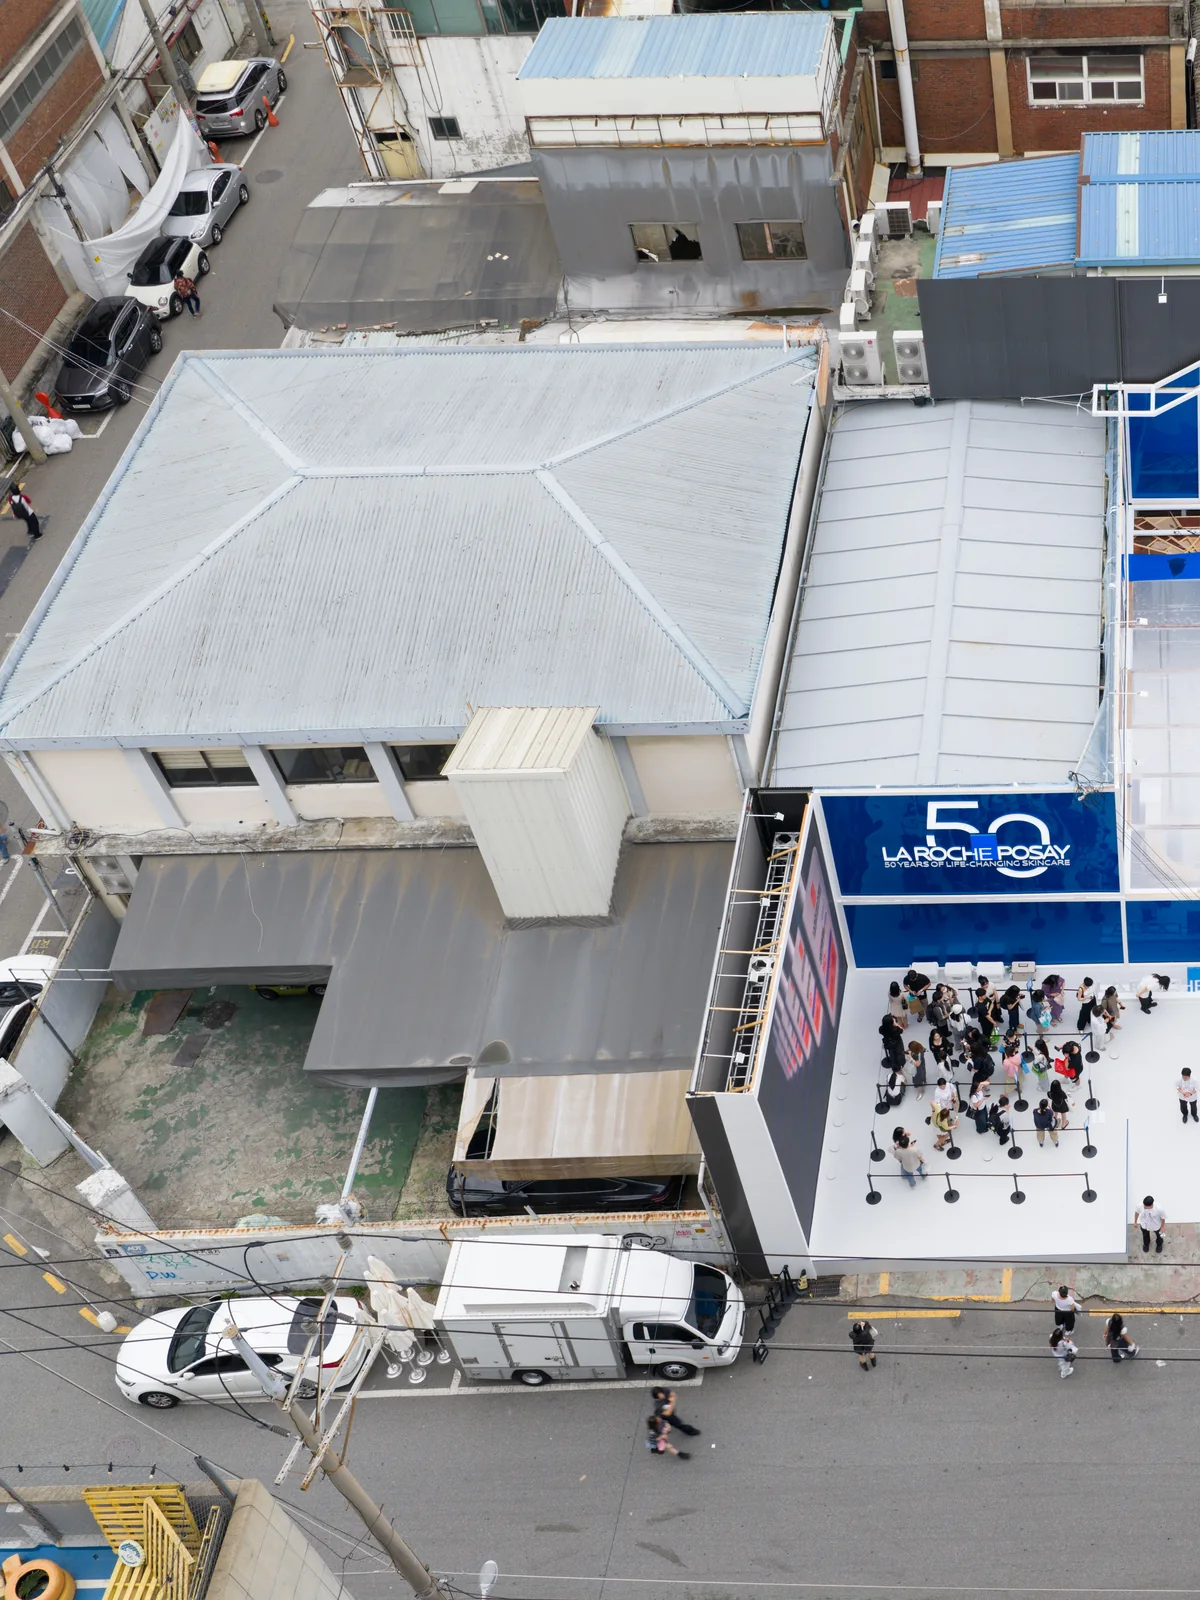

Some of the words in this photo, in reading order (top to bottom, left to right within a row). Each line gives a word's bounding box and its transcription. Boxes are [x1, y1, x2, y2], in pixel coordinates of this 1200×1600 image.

[882, 846, 912, 861] LA
[913, 846, 993, 861] ROCHE
[997, 845, 1070, 861] POSAY
[946, 860, 1020, 868] LIFE-CHANGING
[1022, 859, 1071, 867] SKINCARE
